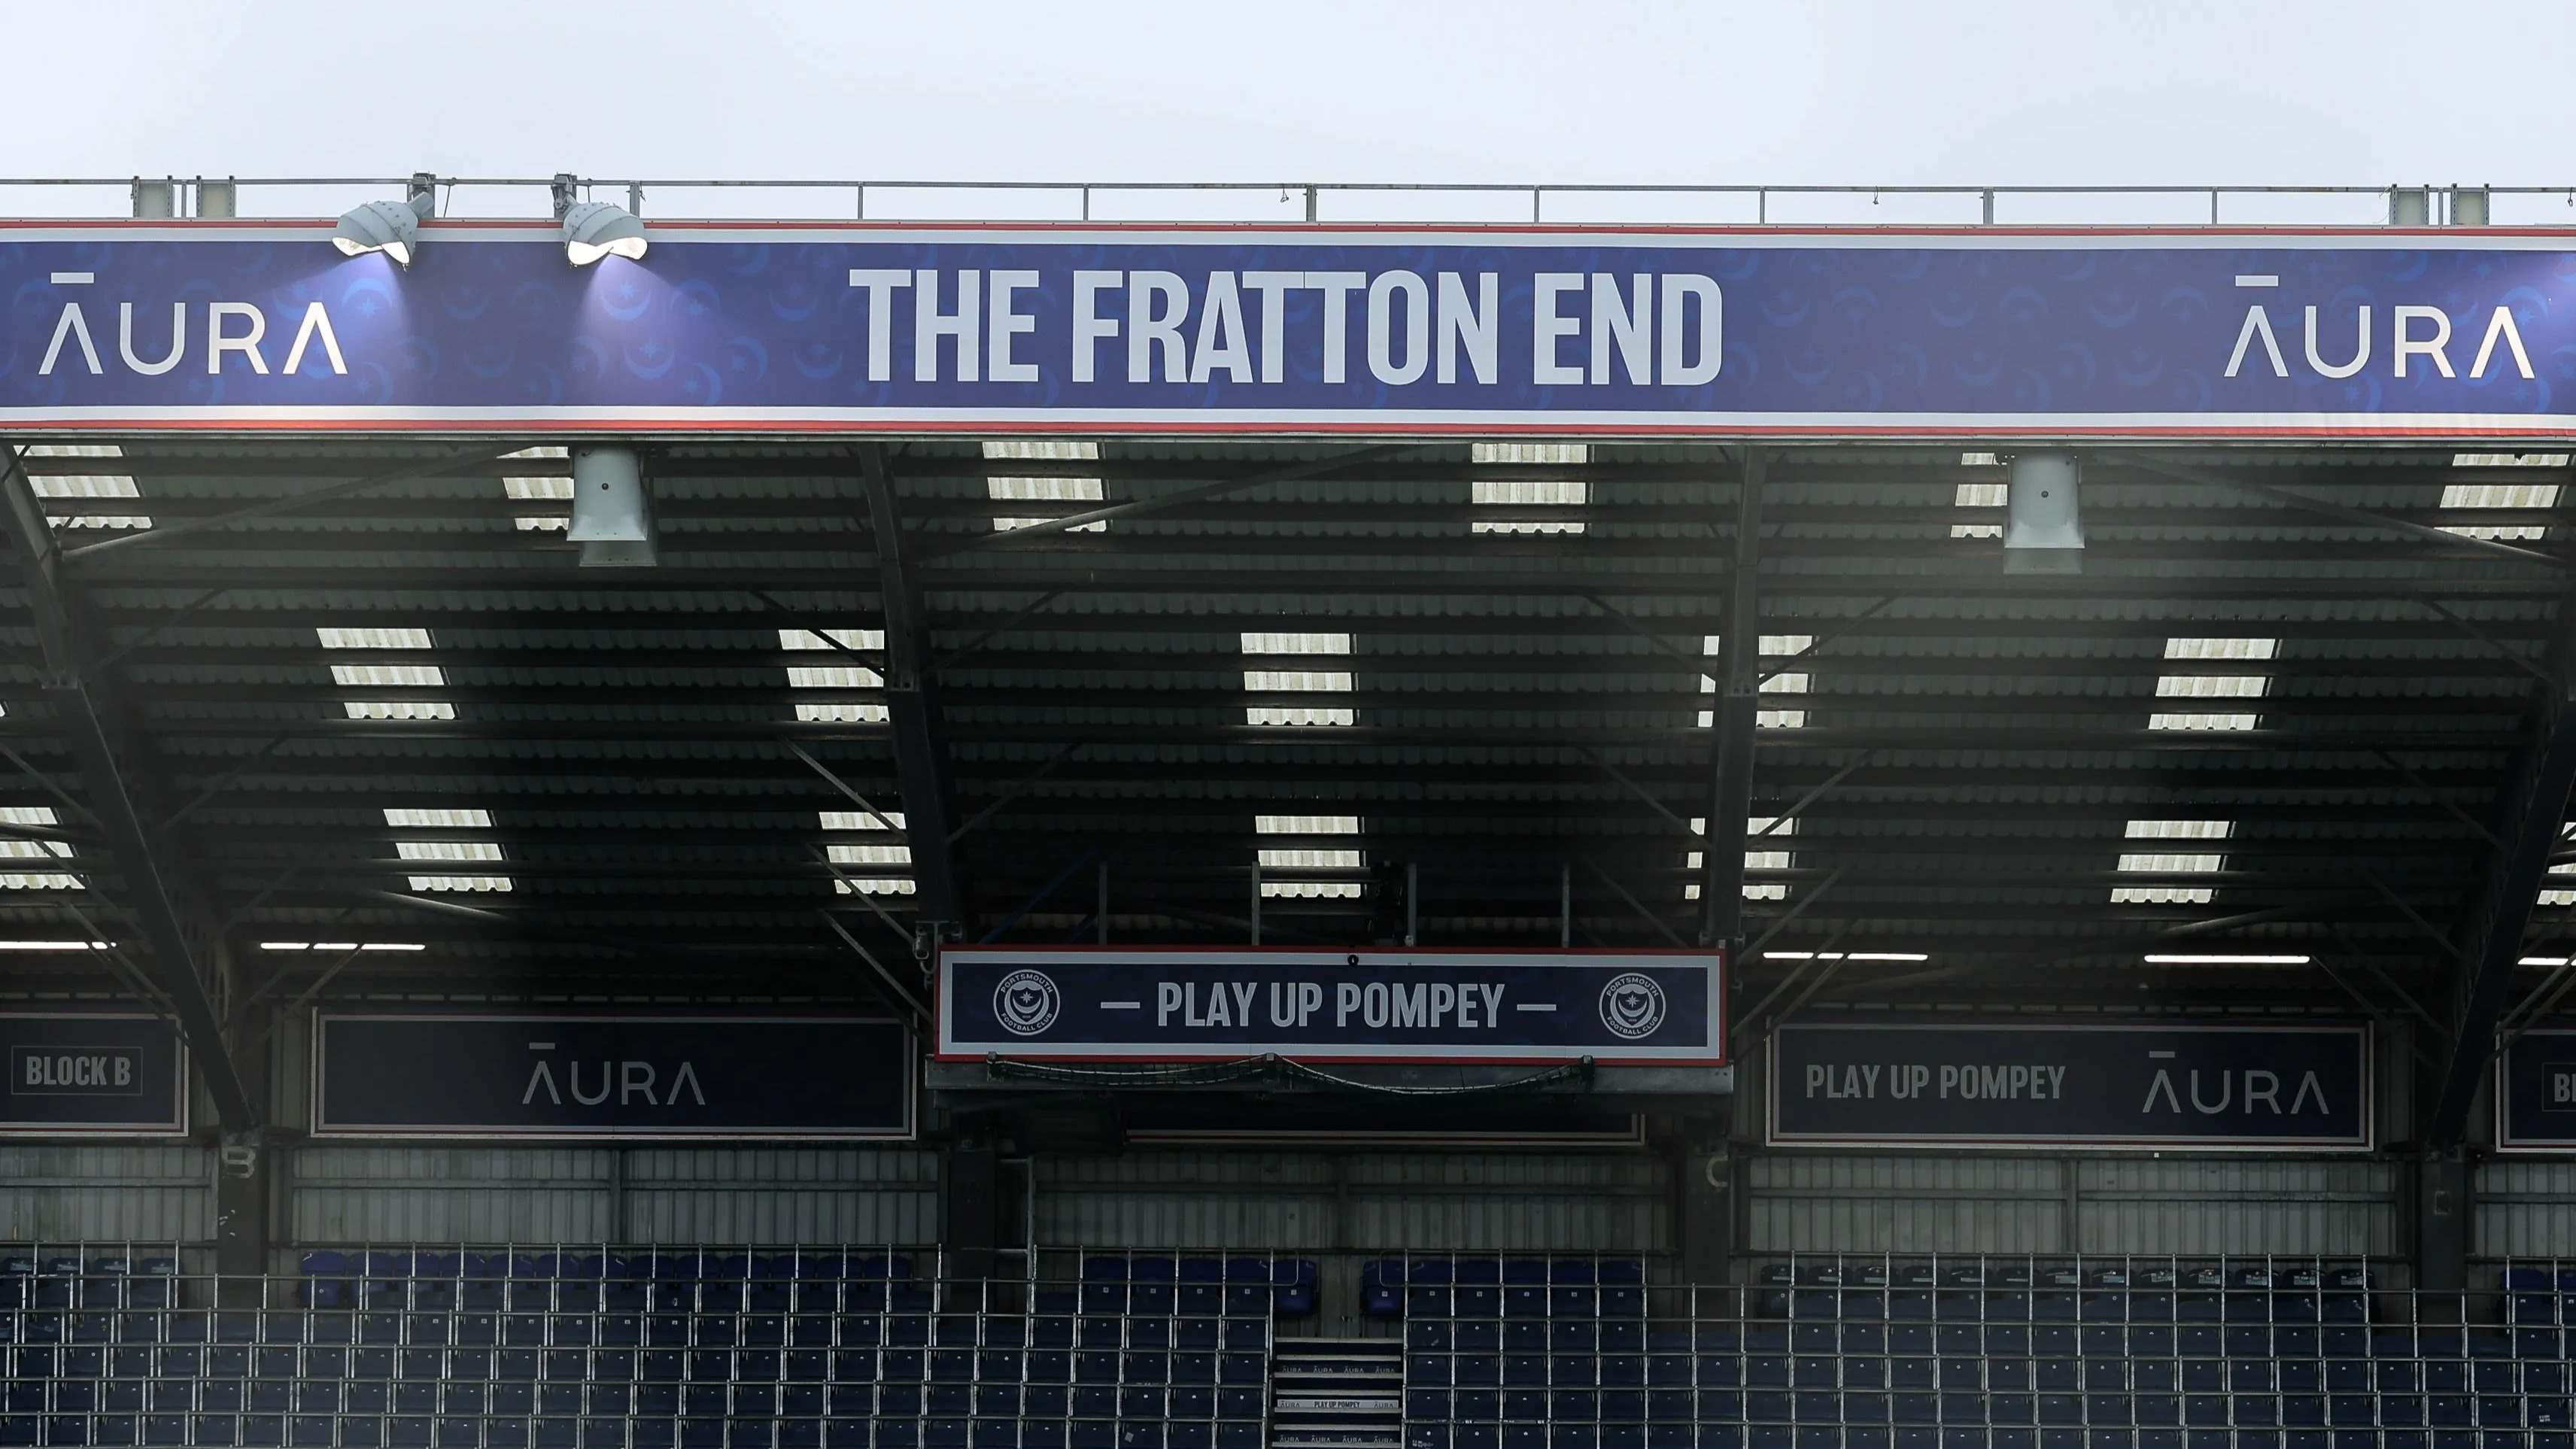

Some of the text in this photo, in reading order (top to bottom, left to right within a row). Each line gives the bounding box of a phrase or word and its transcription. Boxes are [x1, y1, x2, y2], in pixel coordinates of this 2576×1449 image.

[849, 269, 1723, 386] THE FRATTON END
[1001, 974, 1053, 993] PORTSMOUTH
[1606, 977, 1659, 997] PORTSMOUTH
[1158, 982, 1505, 1028] PLAY UP POMPEY
[1001, 1012, 1053, 1031] FOOTBALL CLUB
[1607, 1016, 1658, 1034] FOOTBALL CLUB
[26, 1056, 131, 1086] BLOCK B
[1806, 1065, 2066, 1099] PLAY UP POMPEY
